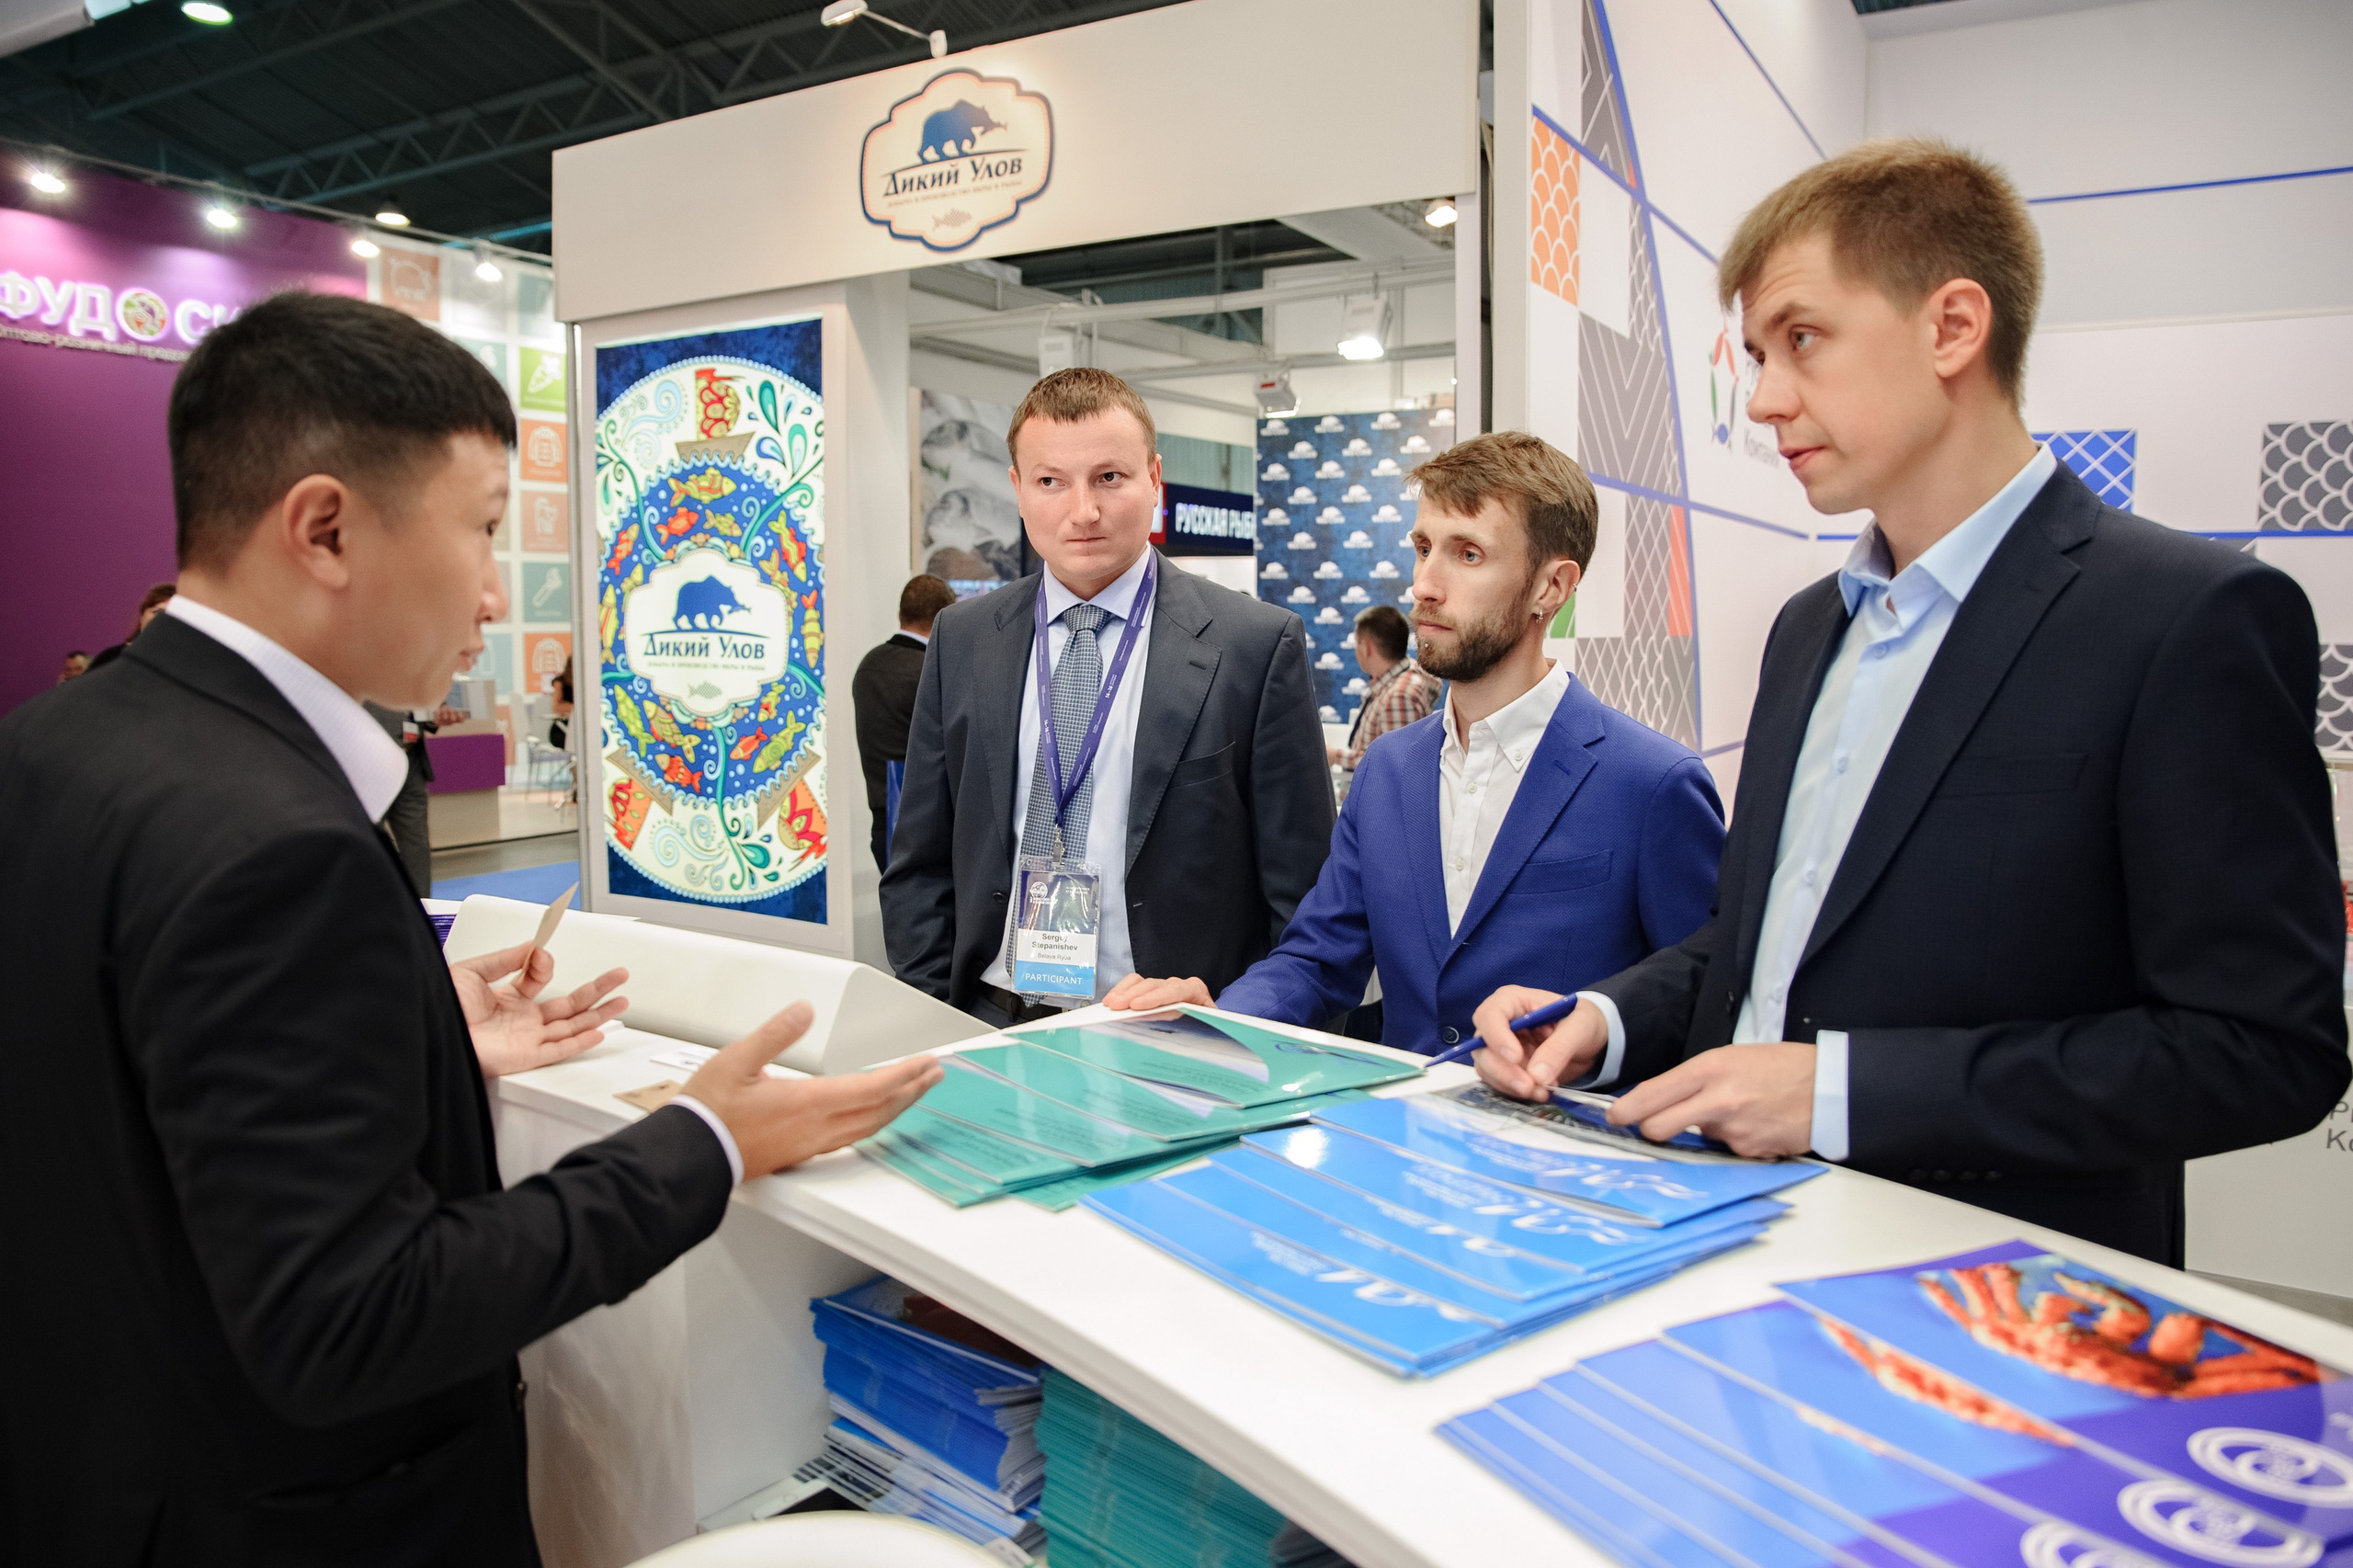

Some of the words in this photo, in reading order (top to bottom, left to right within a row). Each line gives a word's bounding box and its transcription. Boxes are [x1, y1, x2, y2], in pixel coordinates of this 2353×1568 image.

[883, 163, 960, 197] Дикий
[970, 156, 1022, 182] Улов
[1175, 502, 1229, 537] РУССКАЯ
[643, 633, 709, 657] Дикий
[719, 636, 765, 659] Улов
[1031, 940, 1078, 951] Stepanishev
[1025, 972, 1083, 985] PARTICIPANT
